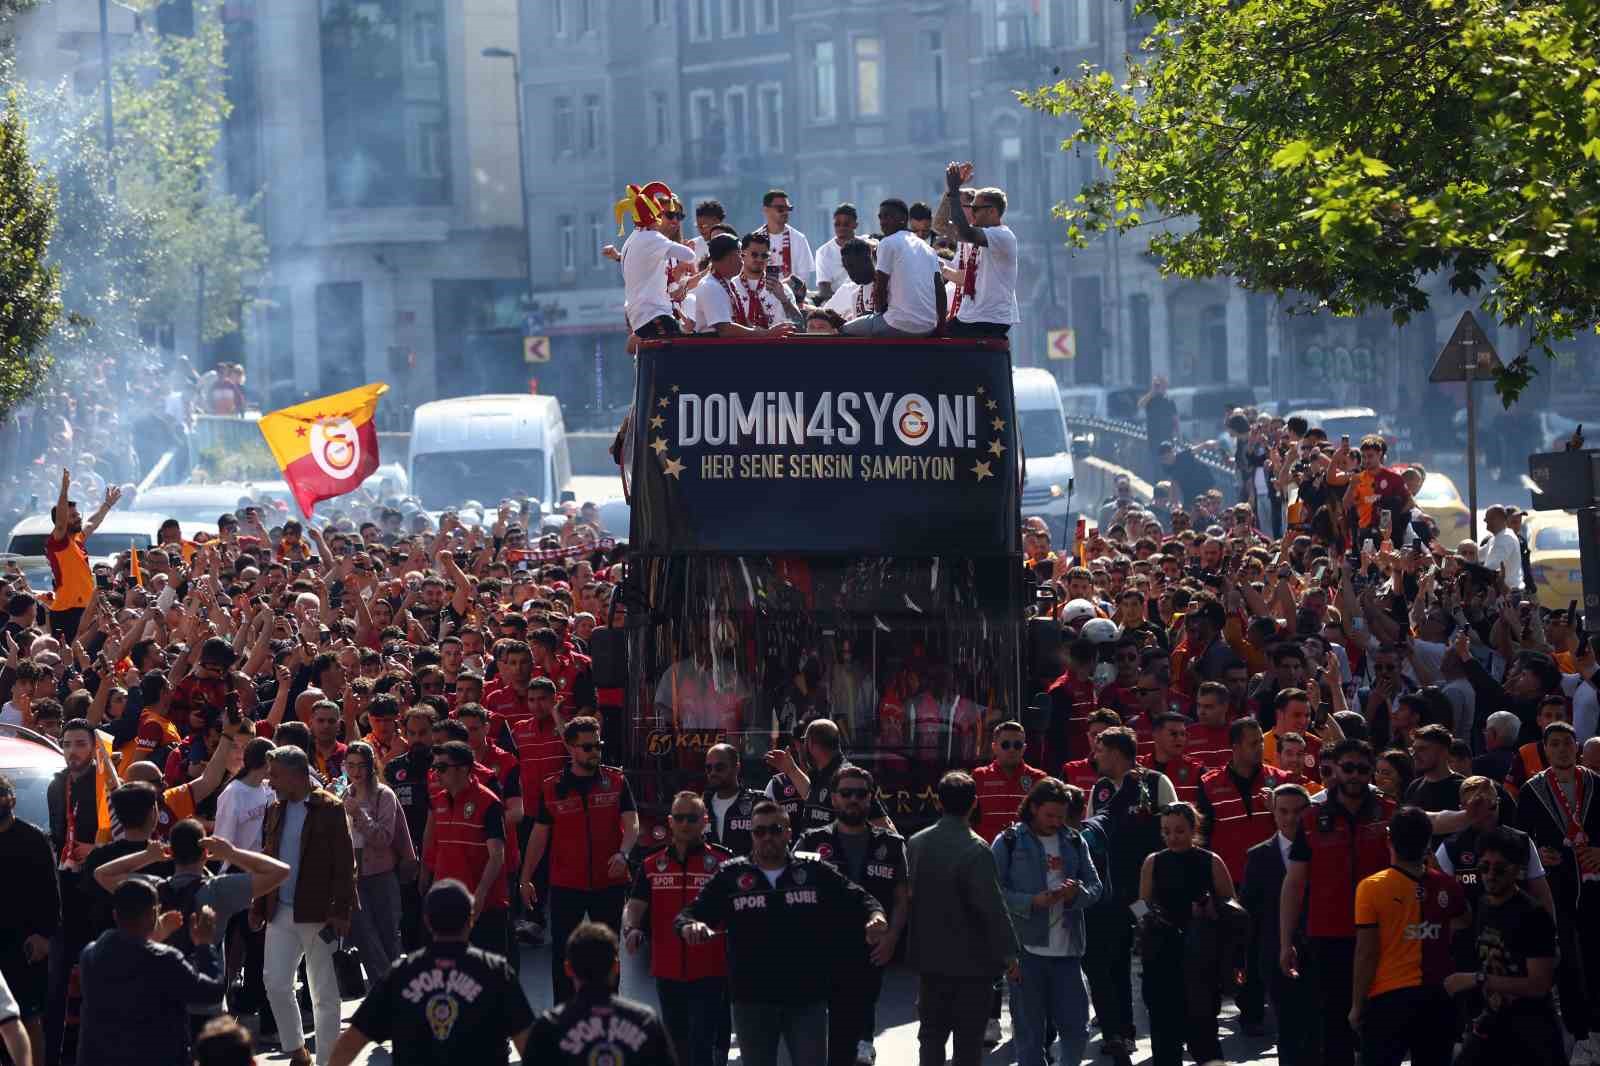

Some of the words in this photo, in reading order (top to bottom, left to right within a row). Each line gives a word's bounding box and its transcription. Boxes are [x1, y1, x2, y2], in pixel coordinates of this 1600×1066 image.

[701, 455, 734, 479] HER
[740, 454, 784, 479] SENE
[733, 896, 766, 911] SPOR
[402, 969, 444, 1003] SPOR
[560, 1017, 605, 1055] SPOR
